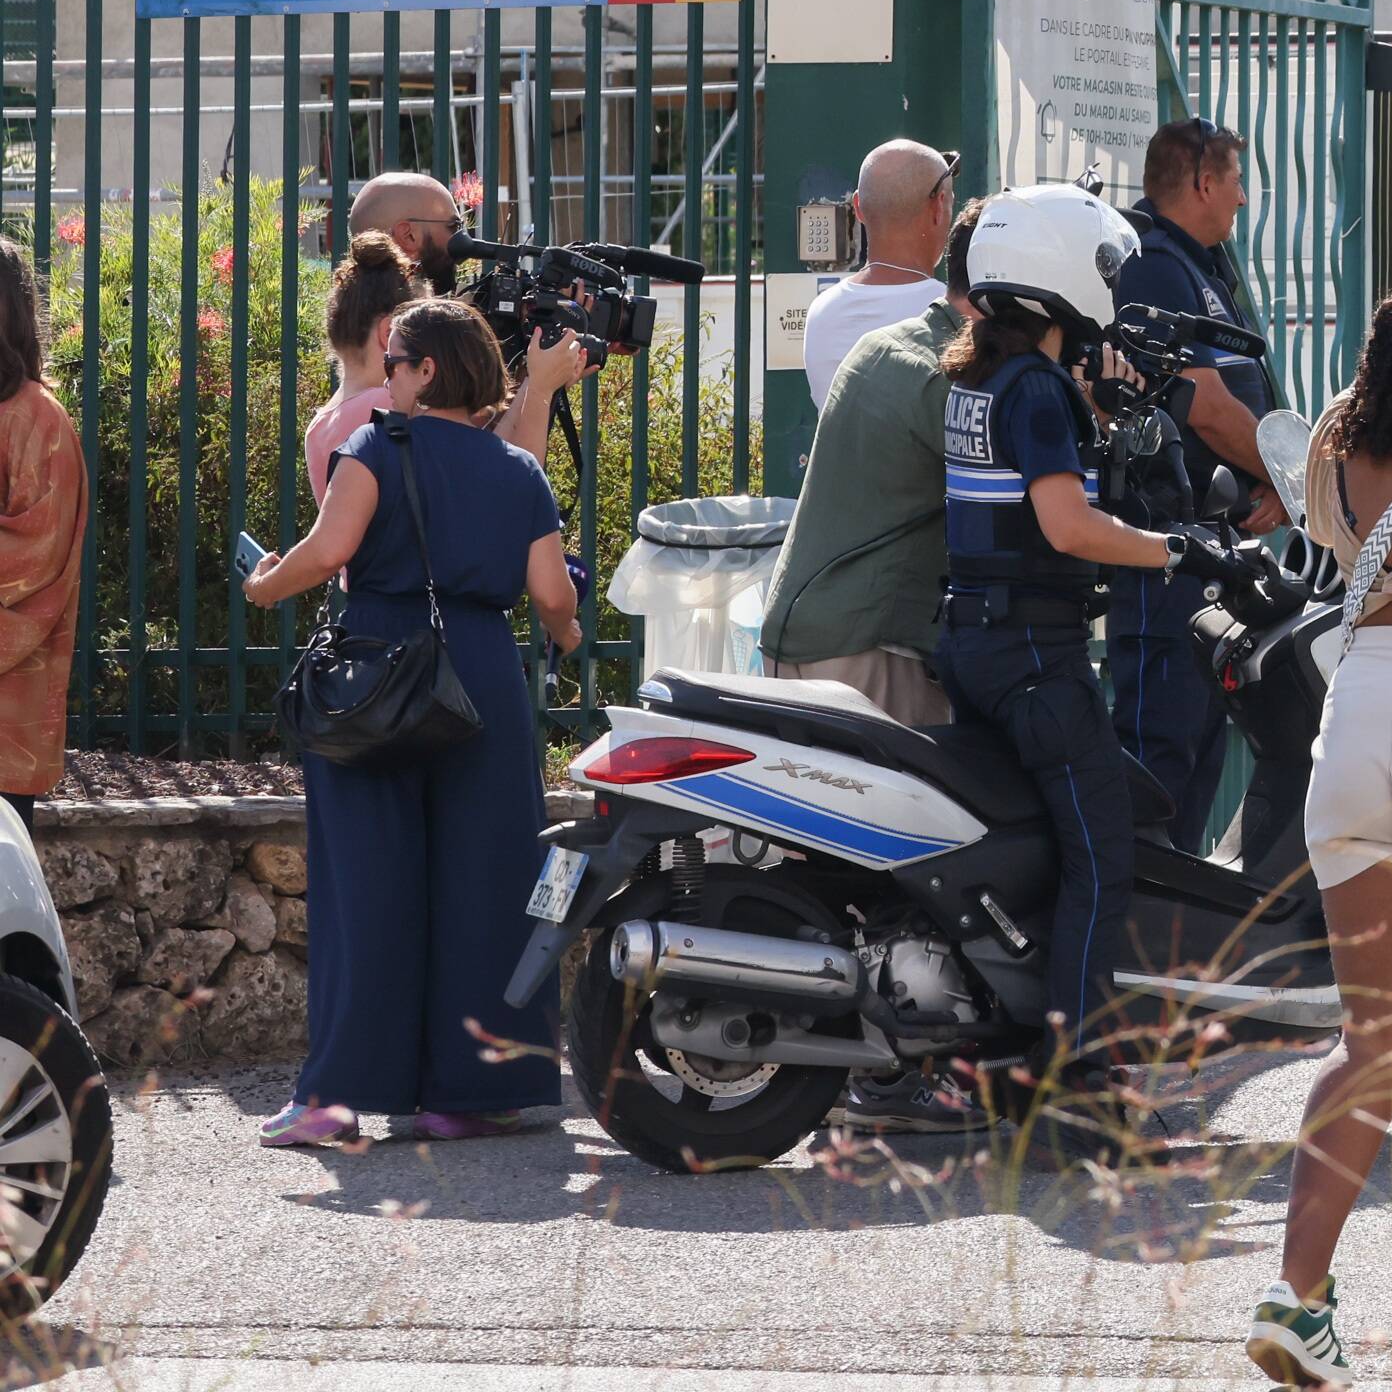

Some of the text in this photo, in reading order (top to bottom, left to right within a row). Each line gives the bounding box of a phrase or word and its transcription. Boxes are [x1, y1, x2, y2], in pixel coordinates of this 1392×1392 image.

[1040, 17, 1068, 35] DANS
[1070, 21, 1080, 36] LE
[1082, 22, 1111, 40] CADRE
[1074, 47, 1085, 62] LE
[1087, 48, 1122, 67] PORTAIL
[1053, 75, 1081, 91] VOTRE
[1084, 78, 1123, 96] MAGASIN
[1074, 103, 1087, 117] DU
[1089, 104, 1118, 120] MARDI
[1119, 106, 1130, 122] AU
[1071, 128, 1083, 142] DE
[1086, 129, 1126, 147] 10H-12H30
[786, 308, 807, 318] SITE
[781, 319, 805, 330] VIDÉ
[945, 392, 987, 433] OLICE
